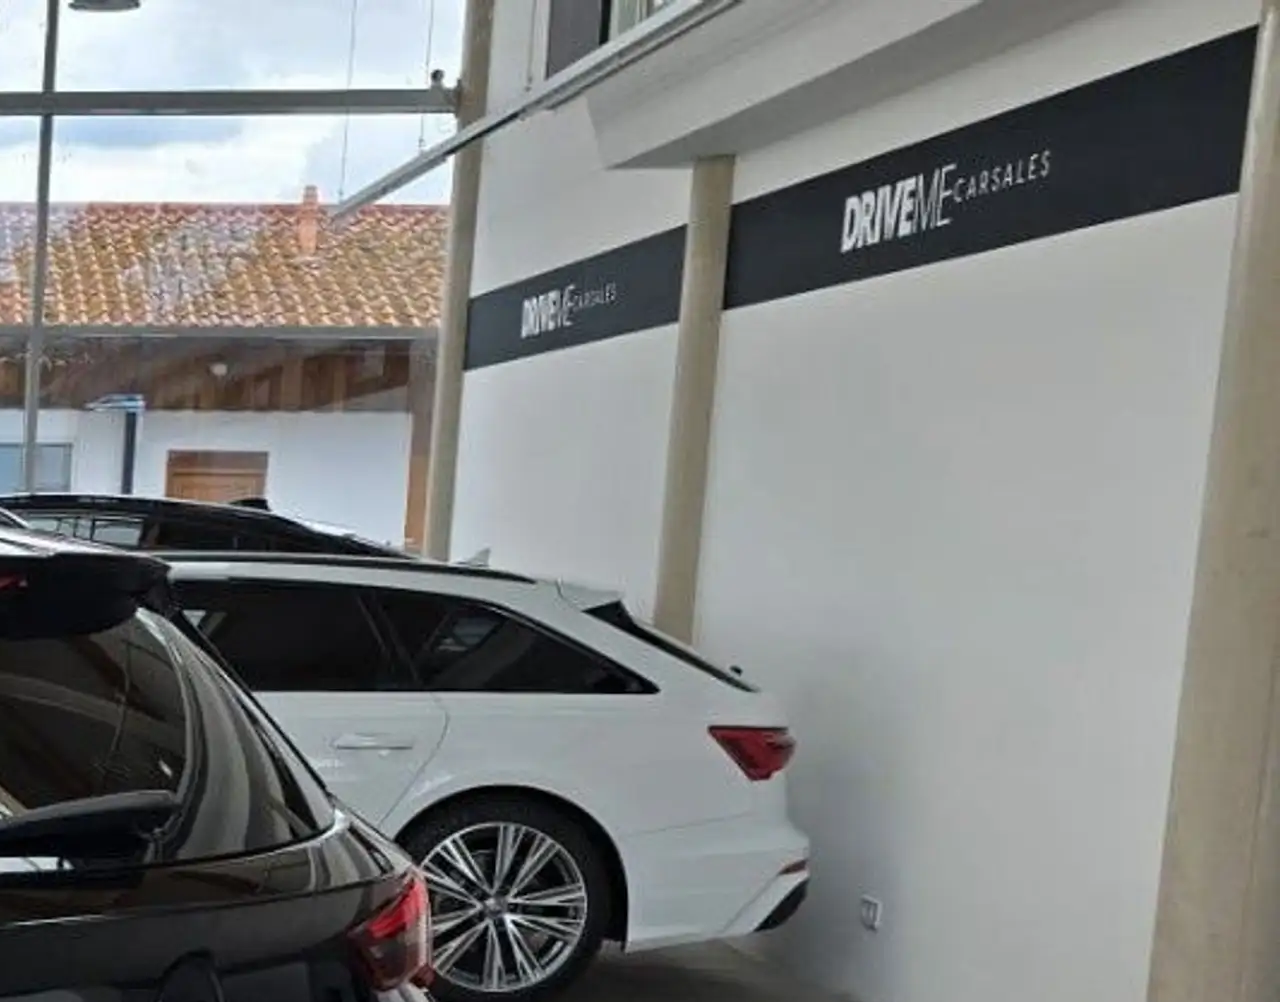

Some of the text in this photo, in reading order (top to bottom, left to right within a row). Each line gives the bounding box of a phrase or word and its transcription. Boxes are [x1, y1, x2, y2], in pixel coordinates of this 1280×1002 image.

[841, 150, 1051, 253] DRIVEME CARSALES
[521, 284, 575, 339] DRIVEME
